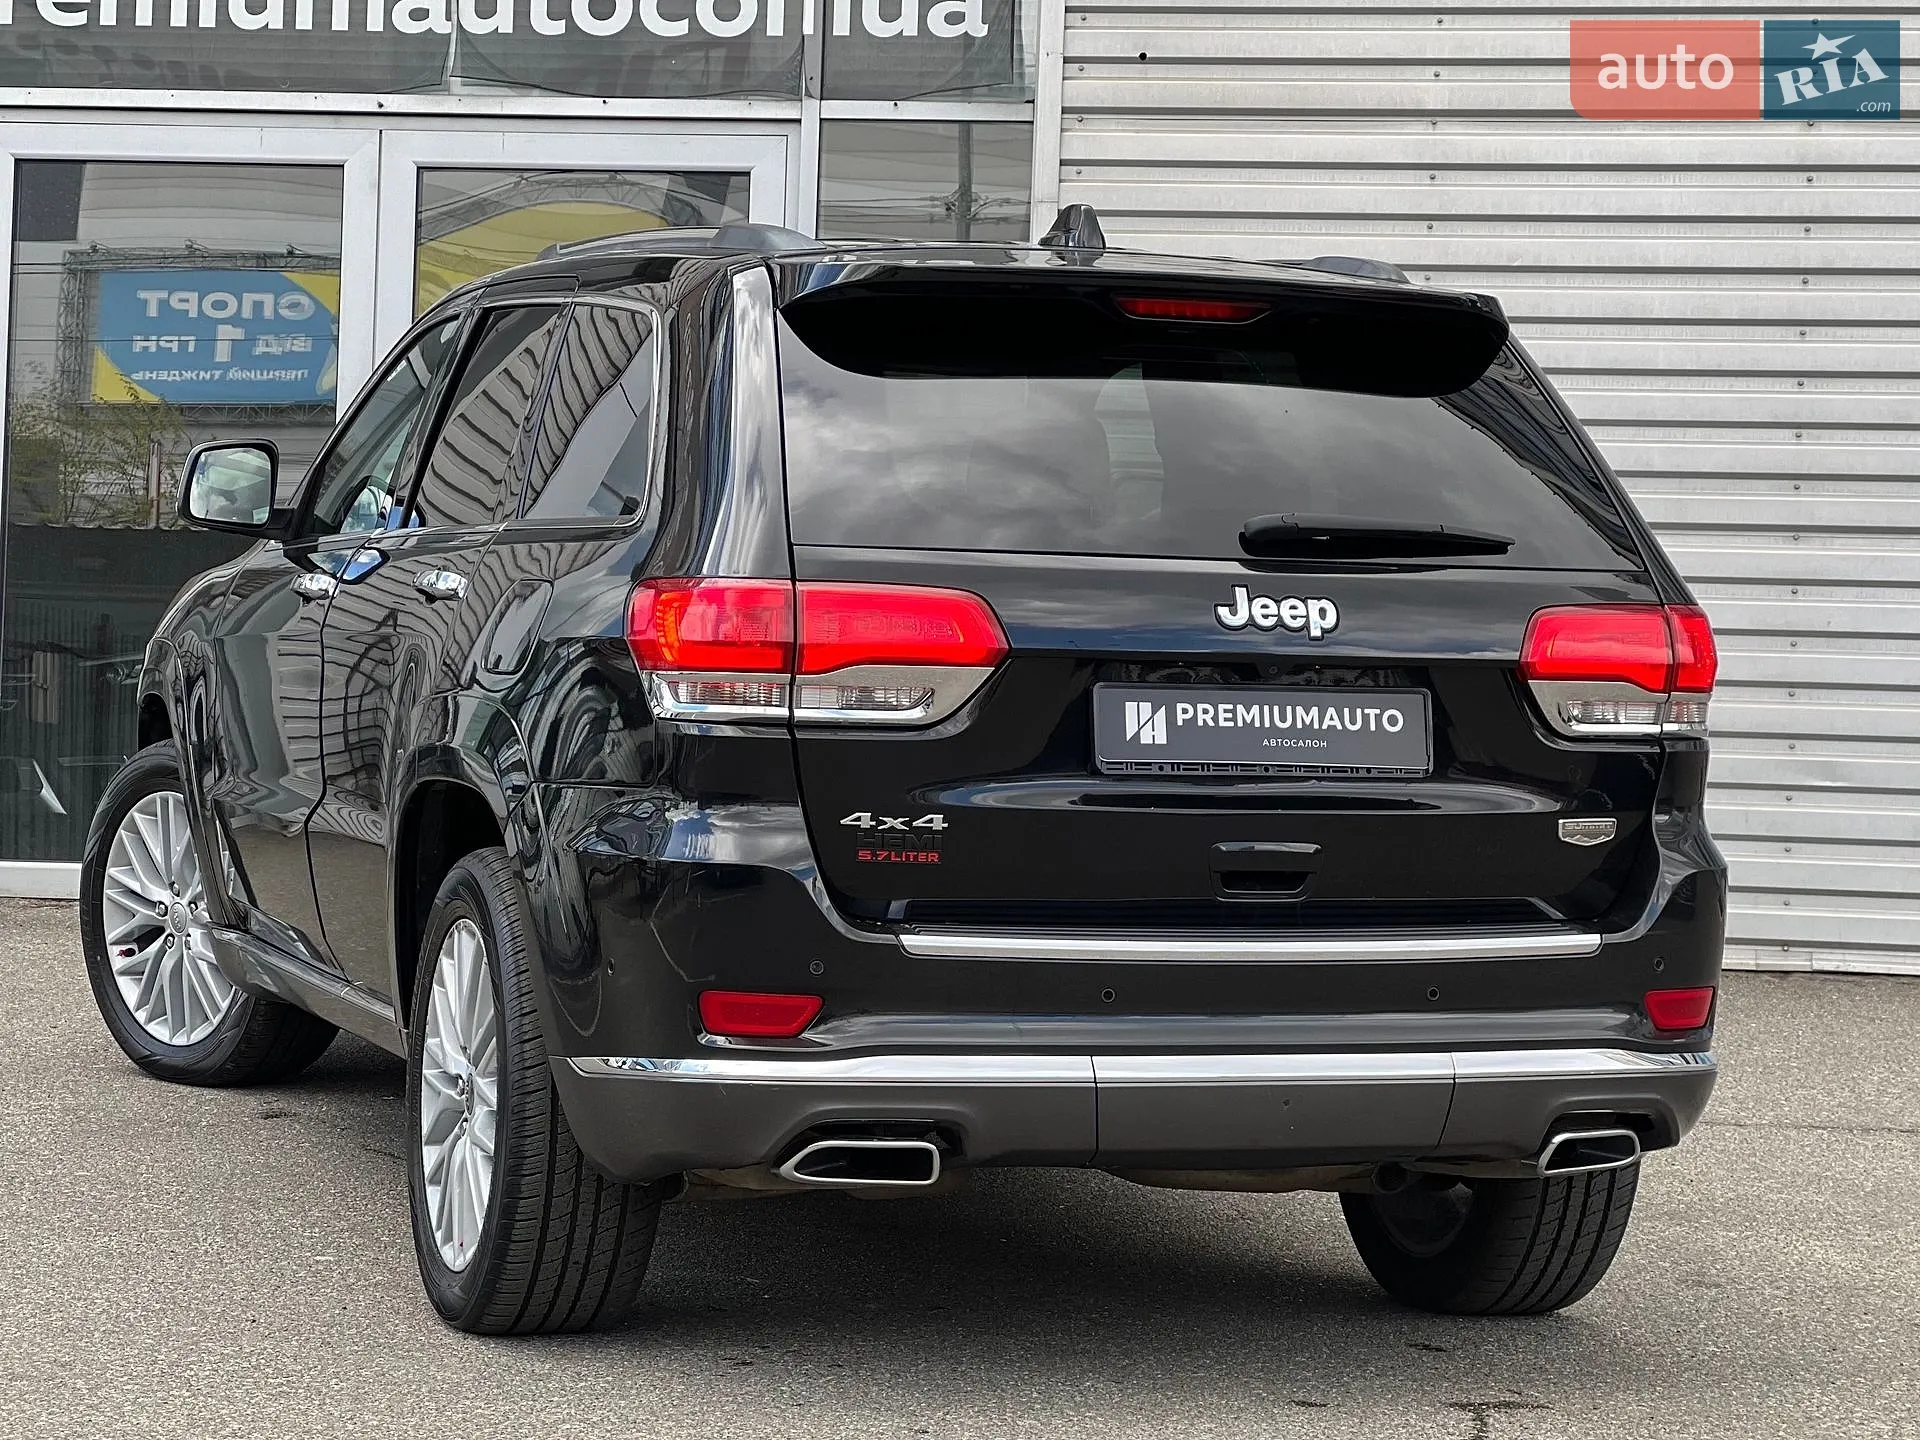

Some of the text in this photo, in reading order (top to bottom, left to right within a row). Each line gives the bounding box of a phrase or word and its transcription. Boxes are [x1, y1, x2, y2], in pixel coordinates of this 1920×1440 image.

[1215, 585, 1339, 639] Jeep
[1176, 702, 1404, 733] PREMIUMAUTO
[1262, 738, 1328, 748] АВТОСАЛОН
[840, 812, 949, 831] 4x4
[856, 832, 943, 850] HEMI
